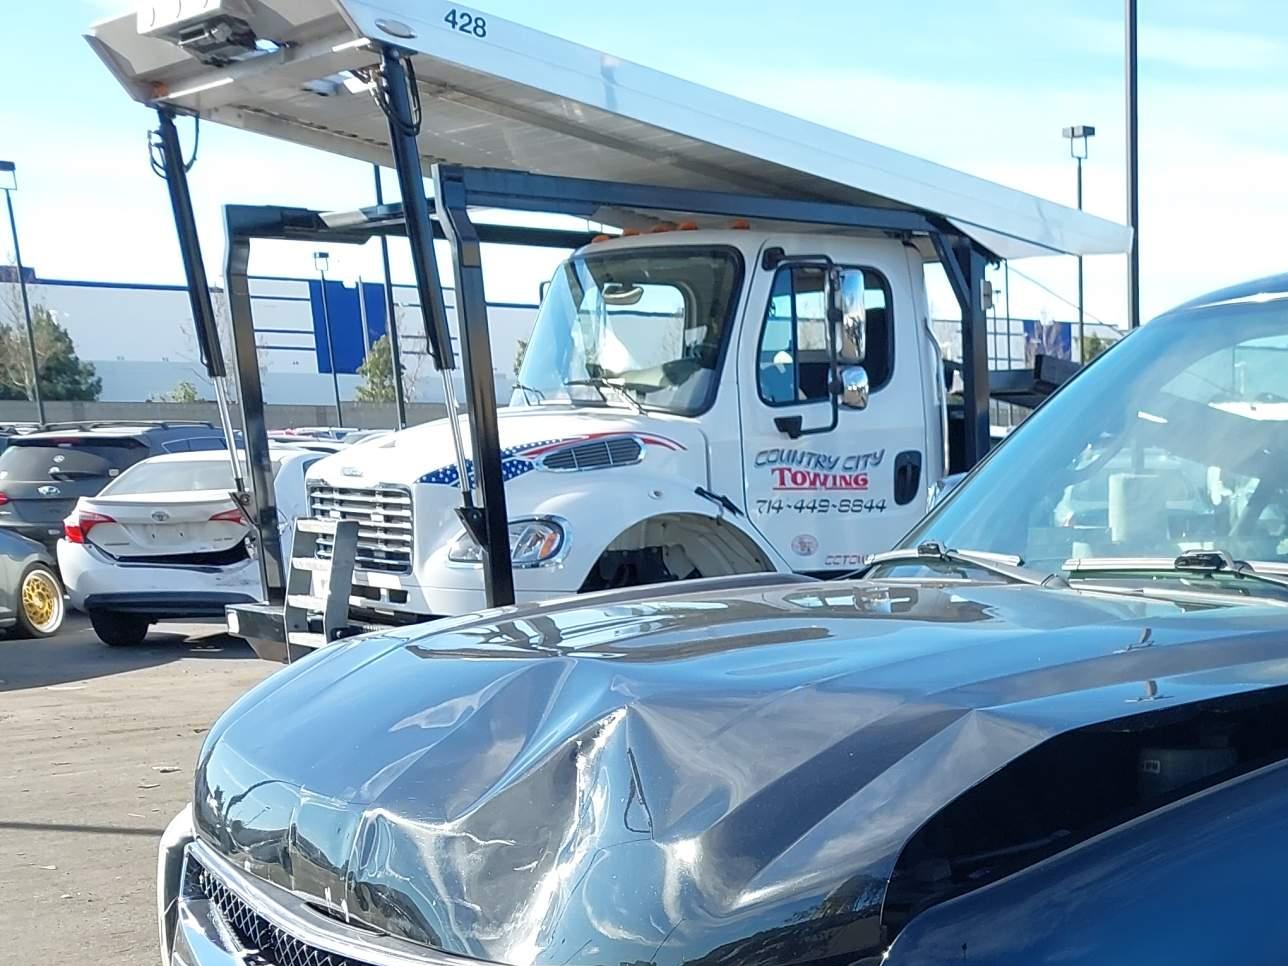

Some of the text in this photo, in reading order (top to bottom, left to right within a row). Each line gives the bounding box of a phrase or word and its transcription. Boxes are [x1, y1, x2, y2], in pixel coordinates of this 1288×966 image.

[444, 9, 487, 38] 428
[754, 448, 886, 471] COUNTRY CITY
[771, 467, 869, 488] TOWING
